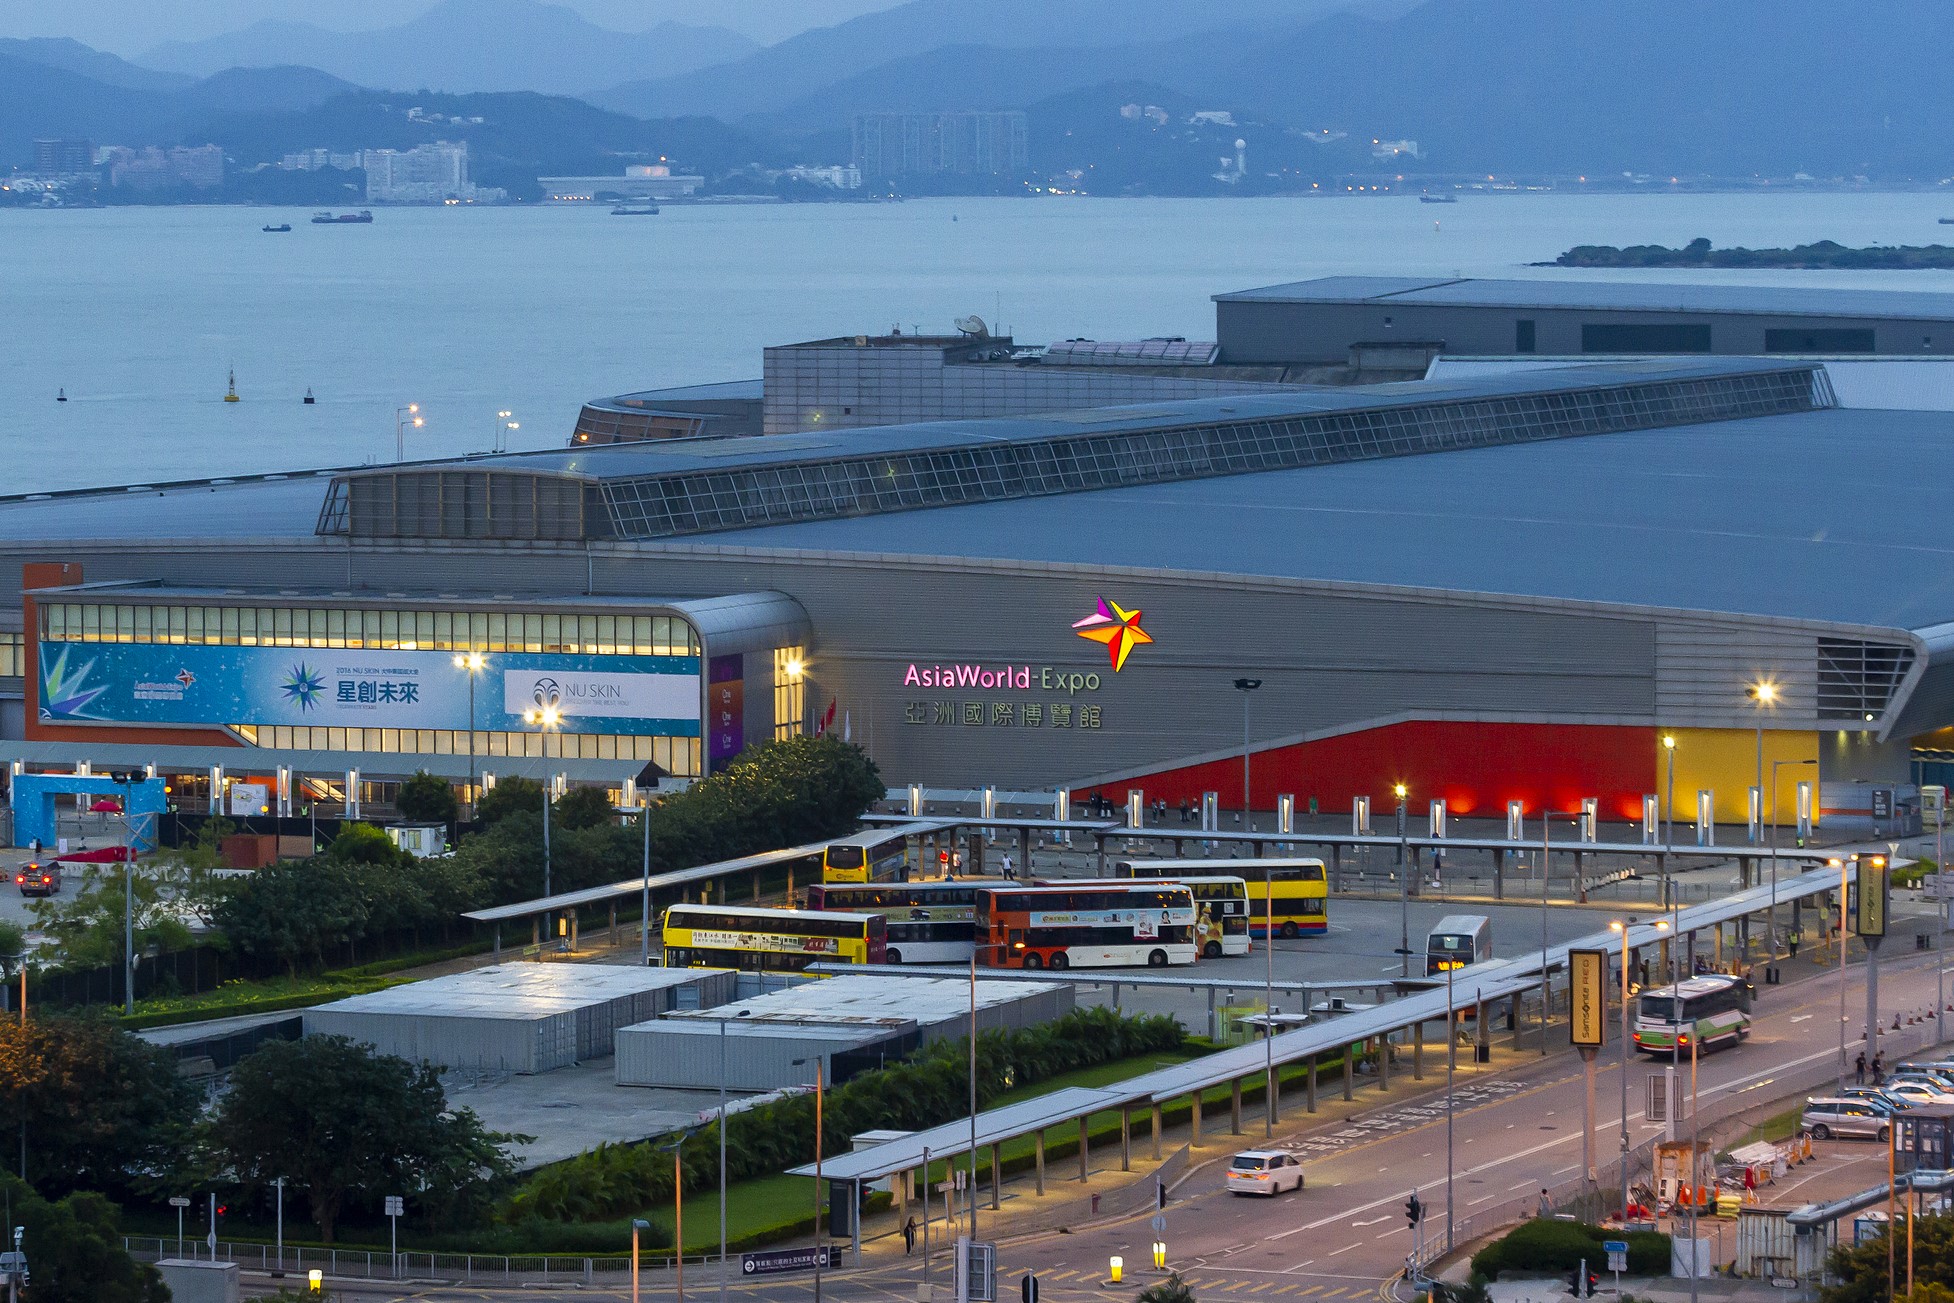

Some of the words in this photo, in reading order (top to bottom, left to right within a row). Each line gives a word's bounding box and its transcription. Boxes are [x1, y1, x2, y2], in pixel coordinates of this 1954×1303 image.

[337, 681, 419, 704] 星創未來
[565, 683, 587, 697] NU
[590, 684, 620, 698] SKIN
[904, 664, 1100, 695] AsiaWorld-Expo
[905, 701, 1102, 728] 亞洲國際博覽館
[1582, 988, 1590, 1038] Samsonite
